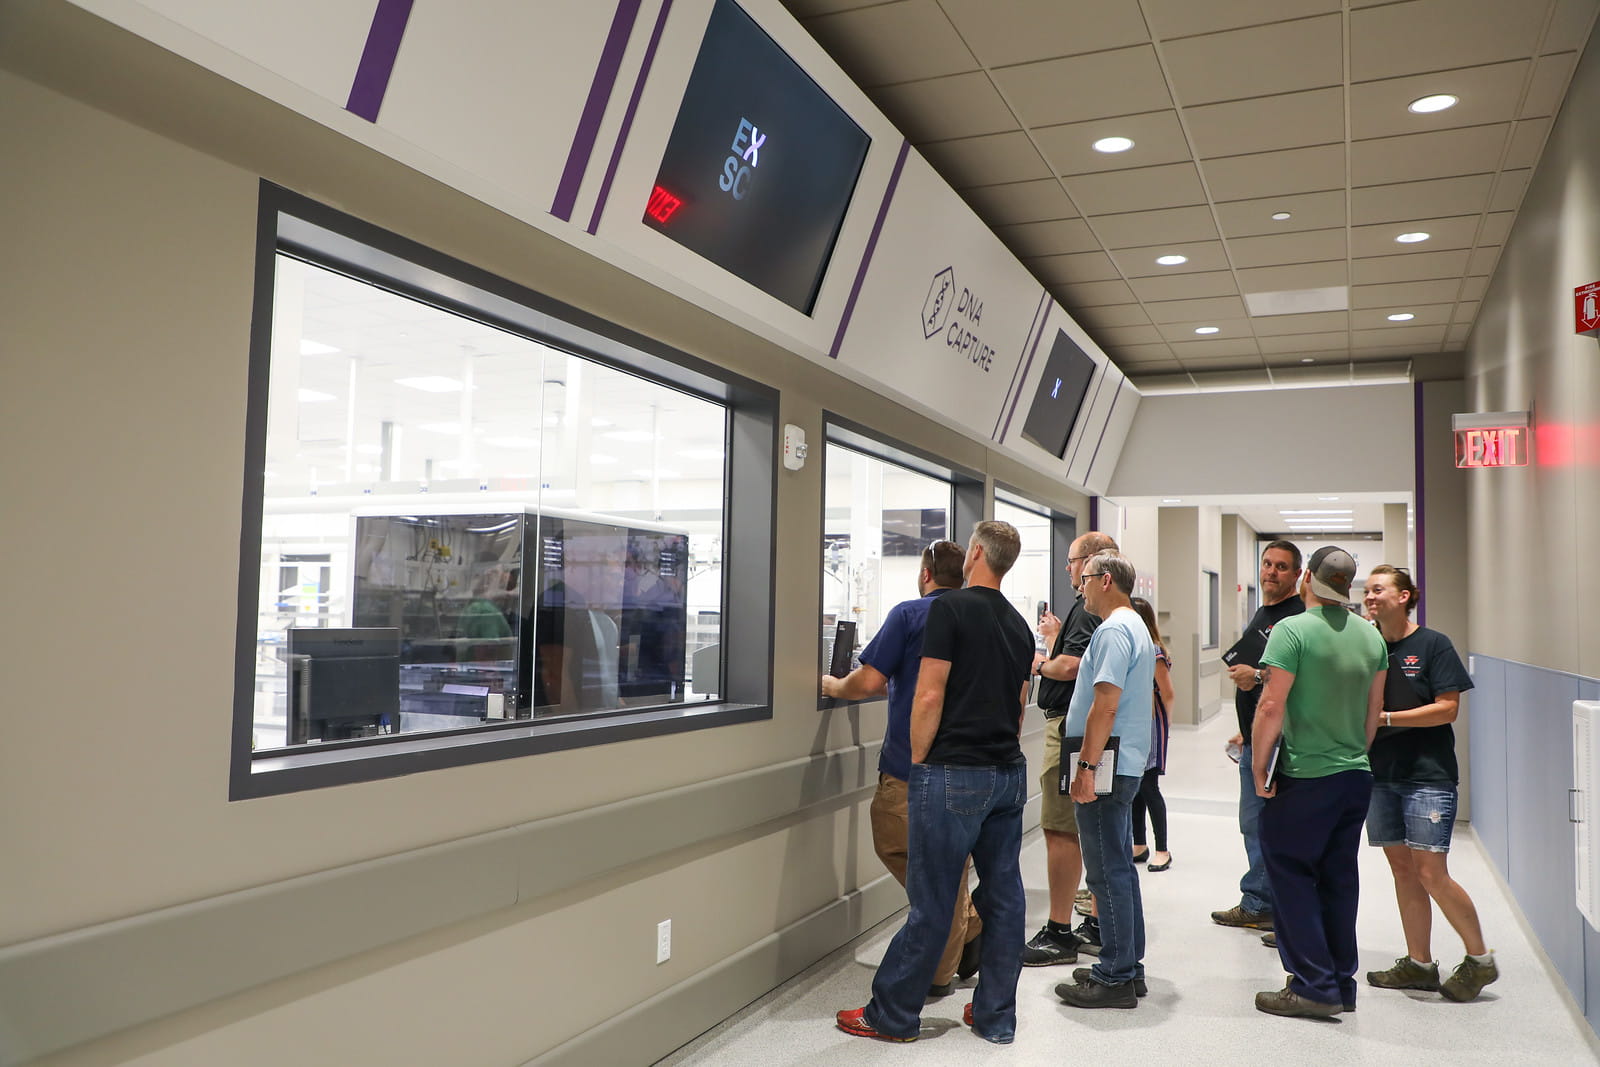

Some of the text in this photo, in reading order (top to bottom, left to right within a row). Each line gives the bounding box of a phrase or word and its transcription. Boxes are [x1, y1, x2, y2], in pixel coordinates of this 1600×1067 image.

[957, 287, 984, 327] DNA
[946, 321, 996, 373] CAPTURE
[1467, 430, 1519, 466] EXIT
